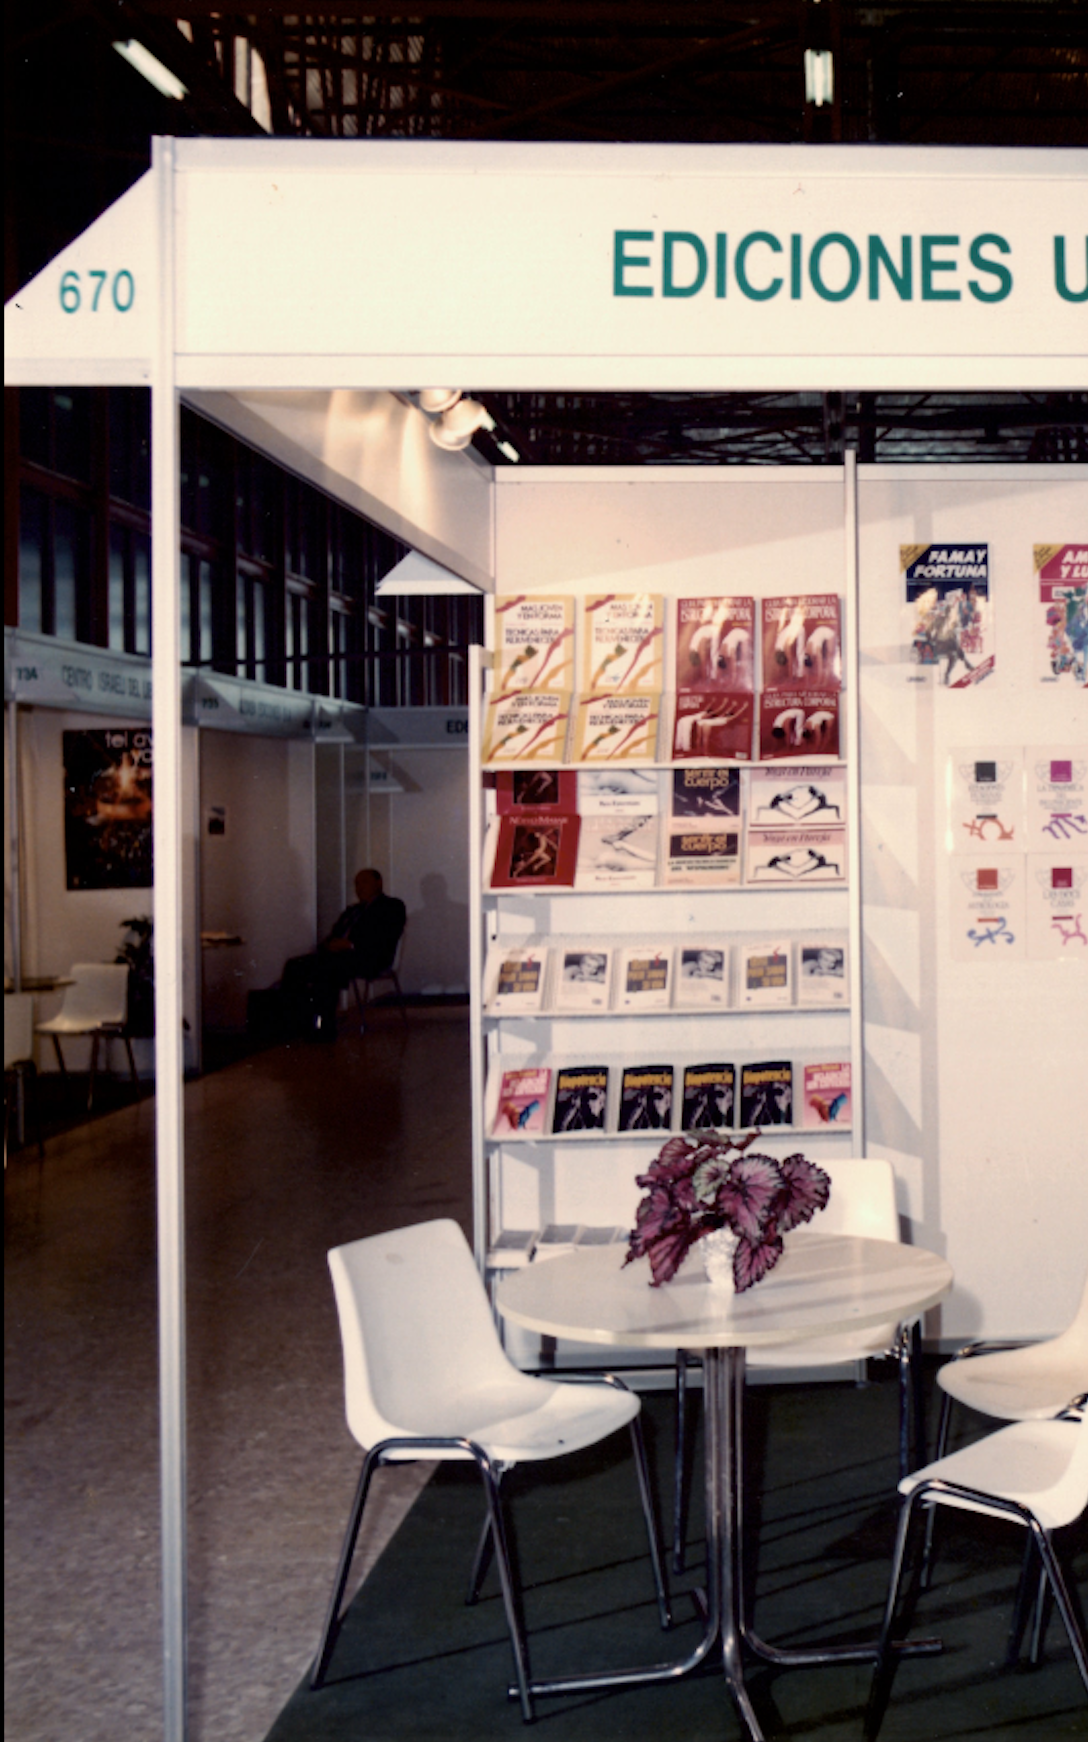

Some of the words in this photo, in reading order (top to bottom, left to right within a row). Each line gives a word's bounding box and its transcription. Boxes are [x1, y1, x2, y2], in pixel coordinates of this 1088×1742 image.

[613, 230, 1013, 304] EDICIONES
[59, 269, 135, 314] 670
[913, 564, 988, 579] FORTUNA
[1060, 564, 1071, 579] Y
[105, 730, 128, 748] tel
[684, 776, 730, 790] cuerpo
